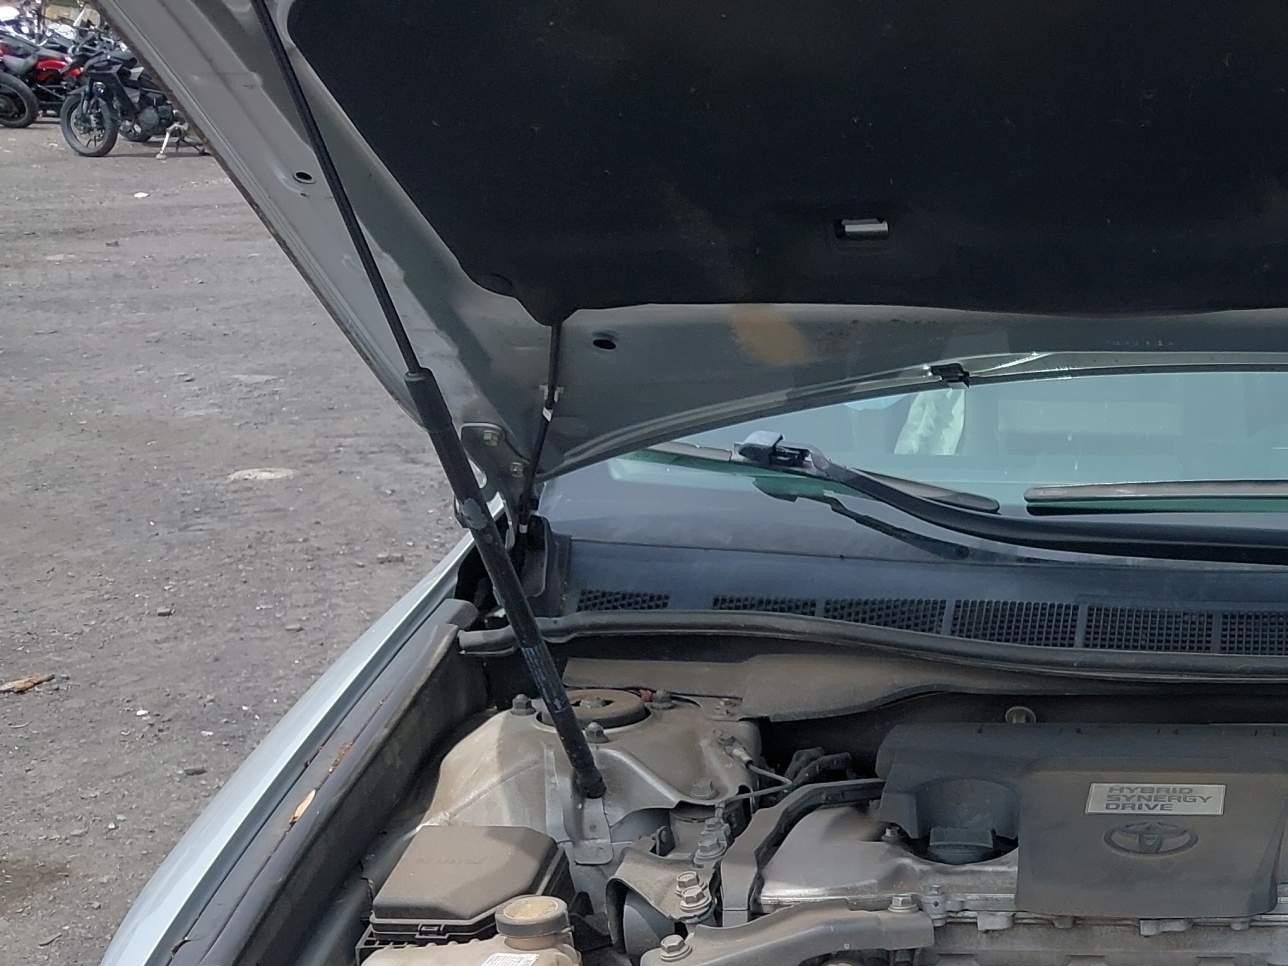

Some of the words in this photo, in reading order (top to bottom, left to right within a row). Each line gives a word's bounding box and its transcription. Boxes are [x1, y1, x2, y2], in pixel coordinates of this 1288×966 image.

[1108, 786, 1193, 794] HYBRID
[1106, 794, 1213, 803] SYNERGY
[1105, 803, 1173, 811] DRIVE
